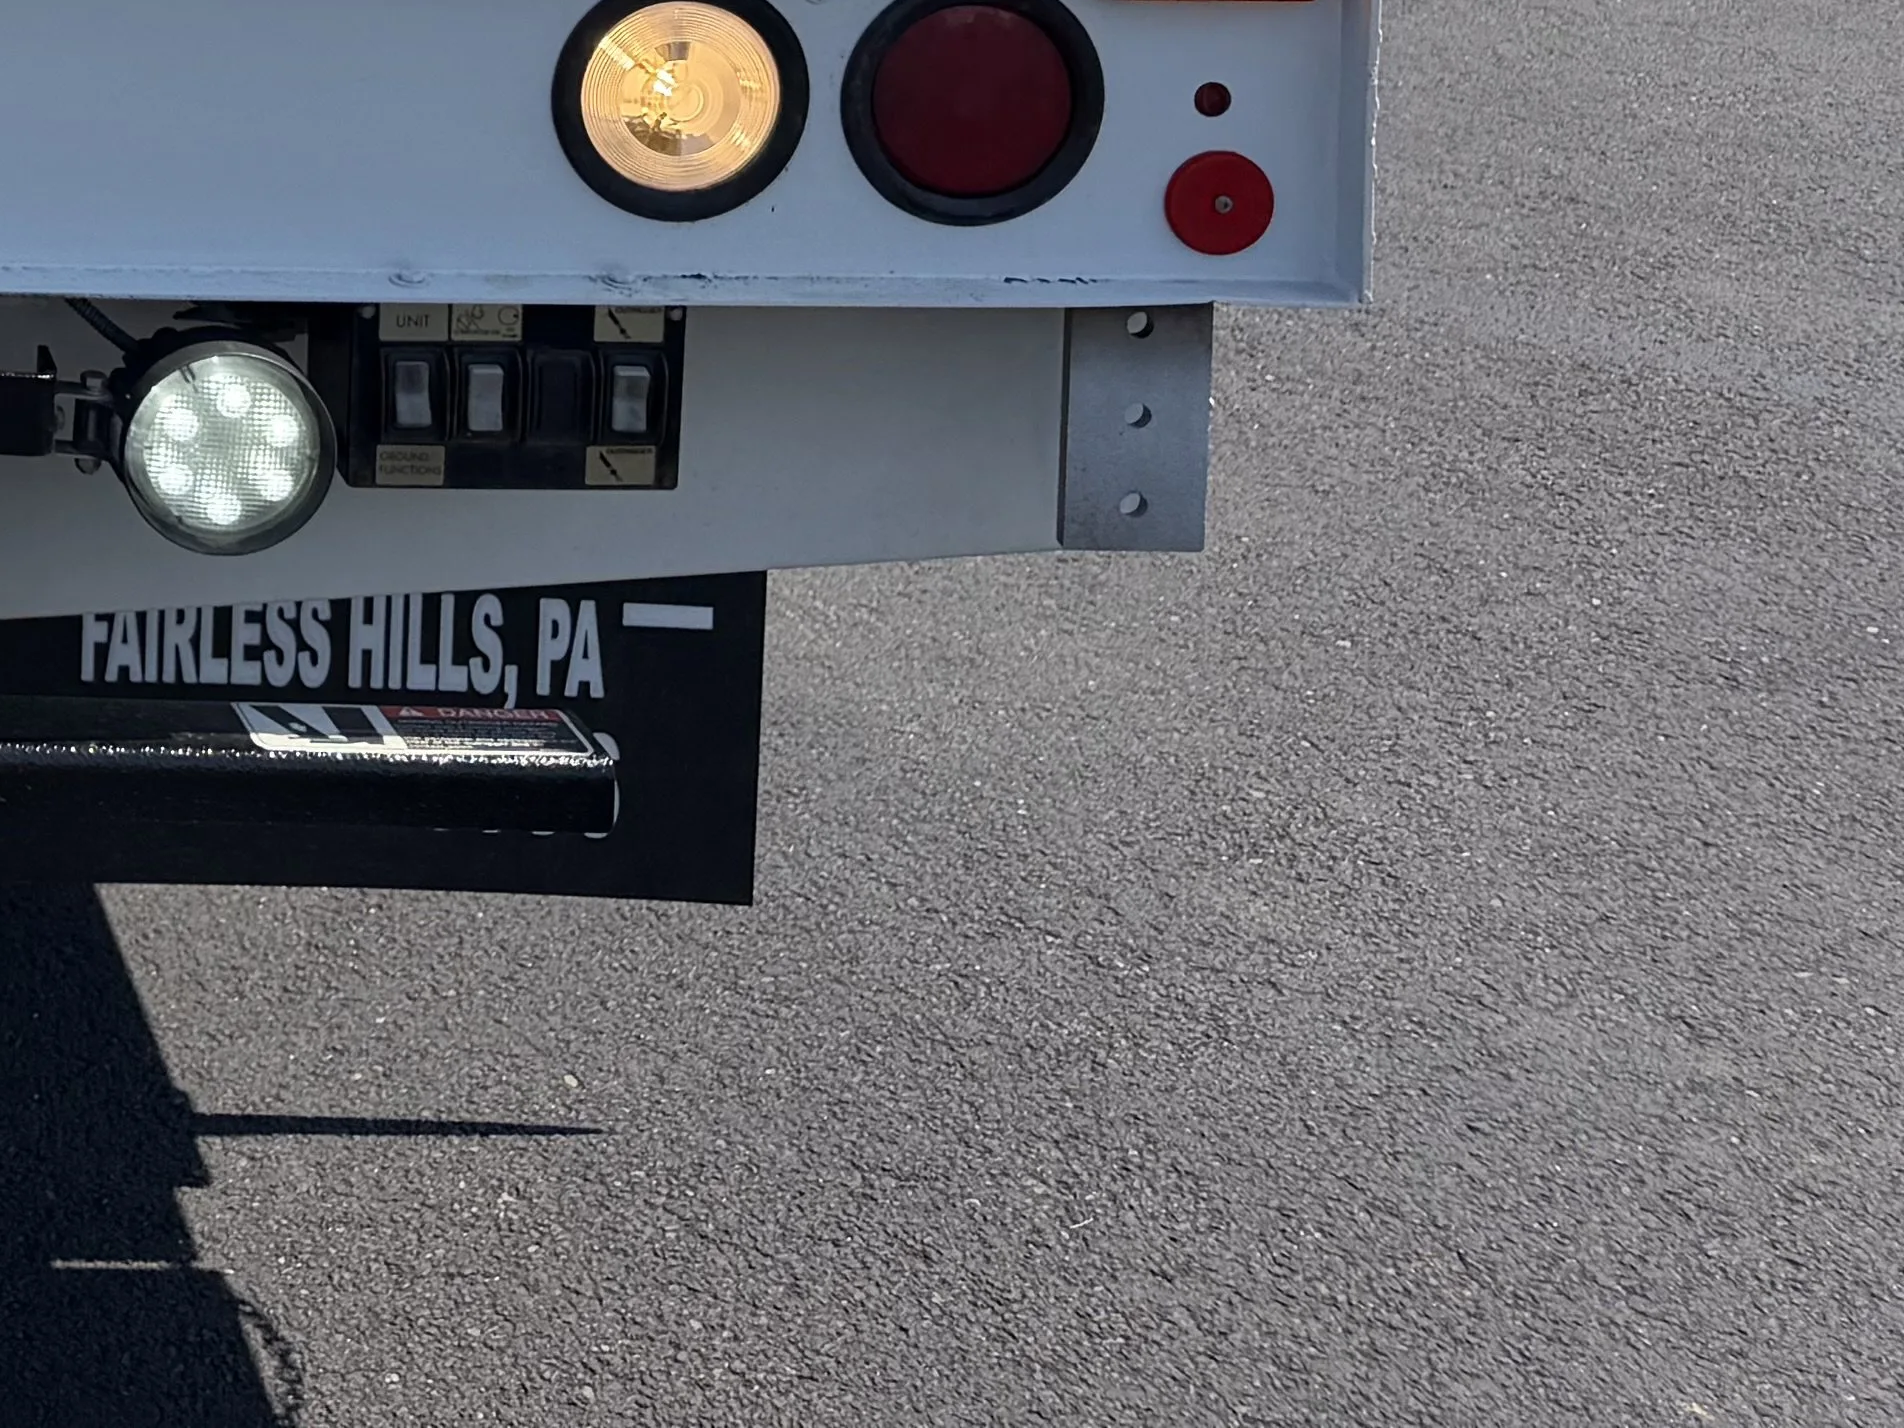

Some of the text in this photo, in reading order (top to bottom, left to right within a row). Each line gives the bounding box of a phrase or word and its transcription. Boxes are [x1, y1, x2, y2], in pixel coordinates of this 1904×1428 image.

[396, 314, 430, 328] UNIT
[379, 451, 430, 462] GROUND
[379, 464, 442, 475] FUNCTIONS
[80, 593, 607, 710] FAIRLESS HILLS, PA
[437, 707, 550, 720] DANGER
